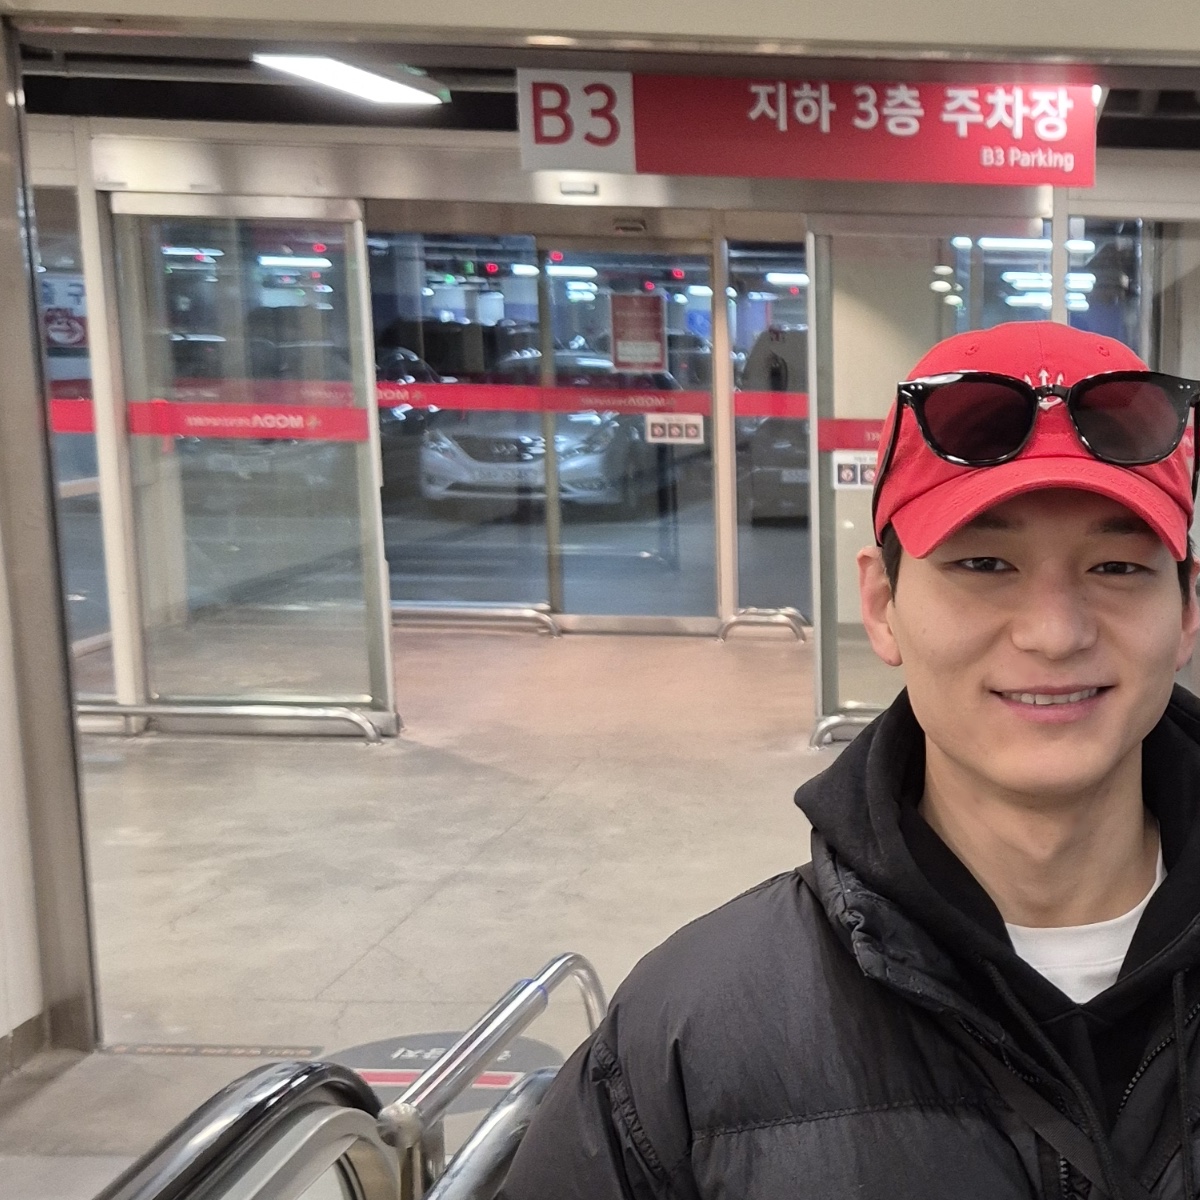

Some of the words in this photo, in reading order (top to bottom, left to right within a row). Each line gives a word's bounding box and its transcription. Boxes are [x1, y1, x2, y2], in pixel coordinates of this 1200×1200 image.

[531, 82, 621, 147] B3
[749, 82, 837, 134] 지하
[853, 84, 925, 137] 3층
[941, 86, 1074, 141] 주차장
[980, 147, 1005, 168] B3
[1009, 148, 1074, 172] Parking
